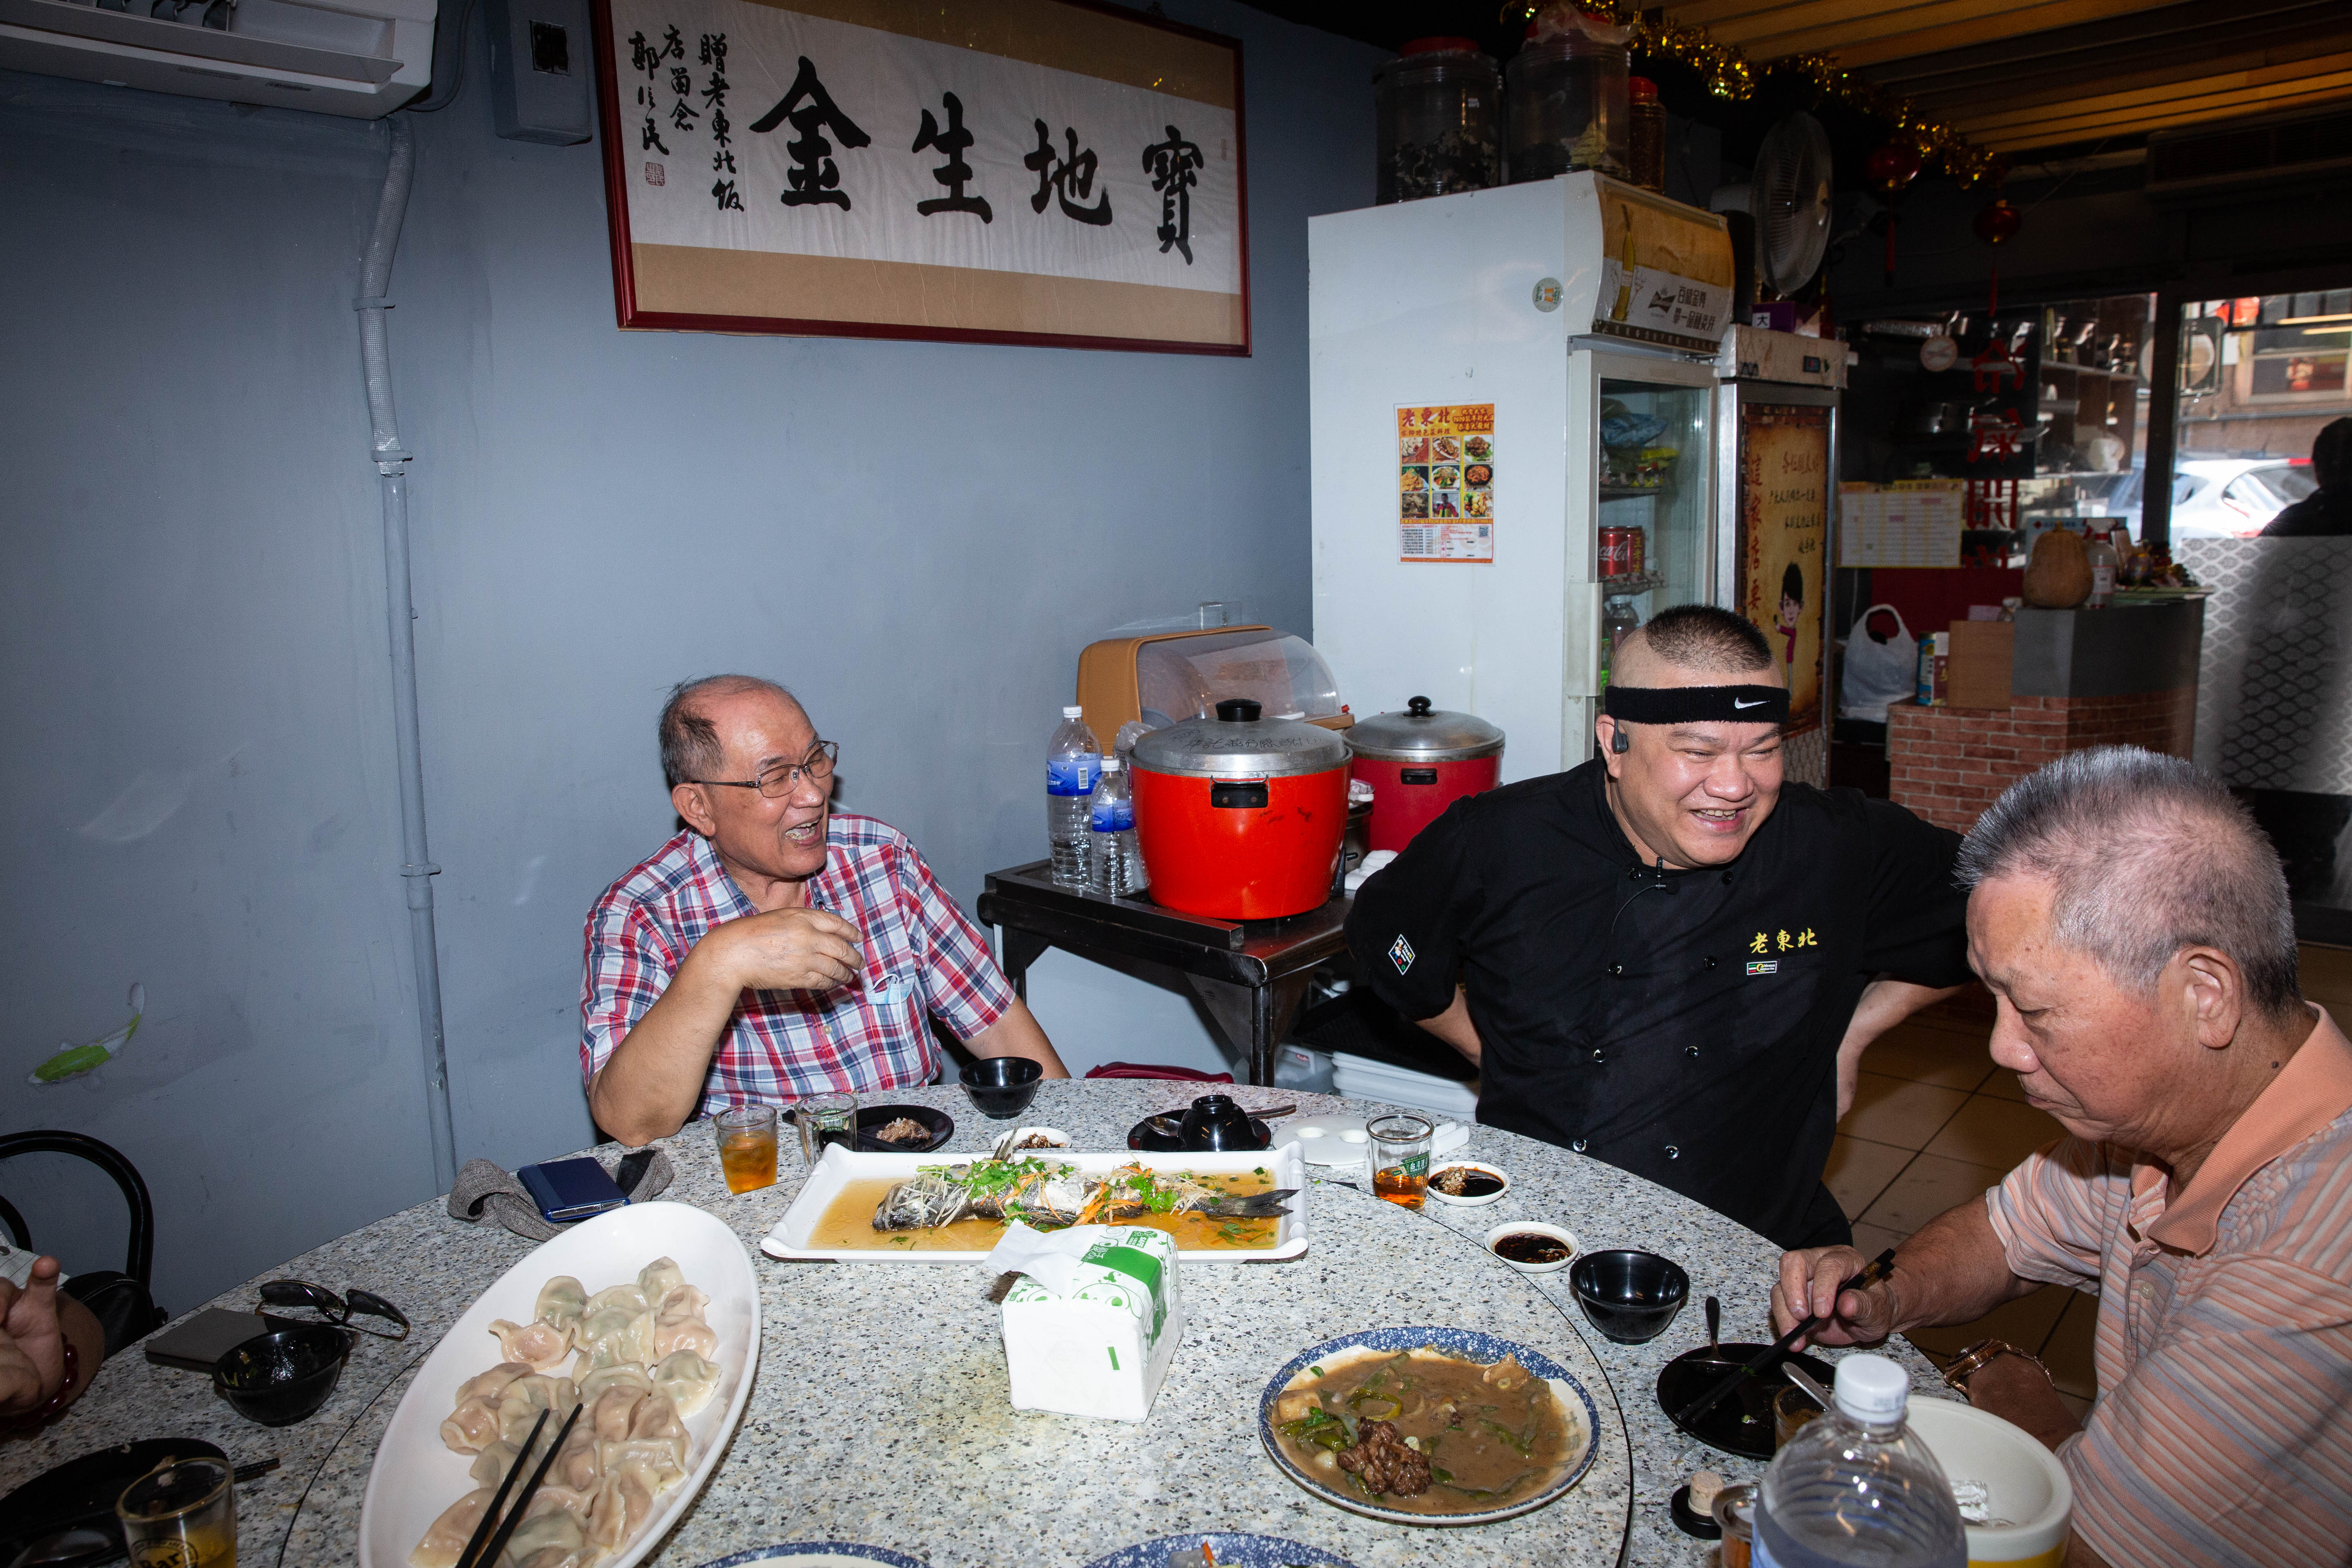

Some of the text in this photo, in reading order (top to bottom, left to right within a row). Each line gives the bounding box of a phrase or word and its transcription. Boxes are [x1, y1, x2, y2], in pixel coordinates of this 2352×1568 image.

[1403, 407, 1450, 427] 老東北
[1750, 927, 1817, 953] 老東北
[1137, 1236, 1147, 1247] SAFE
